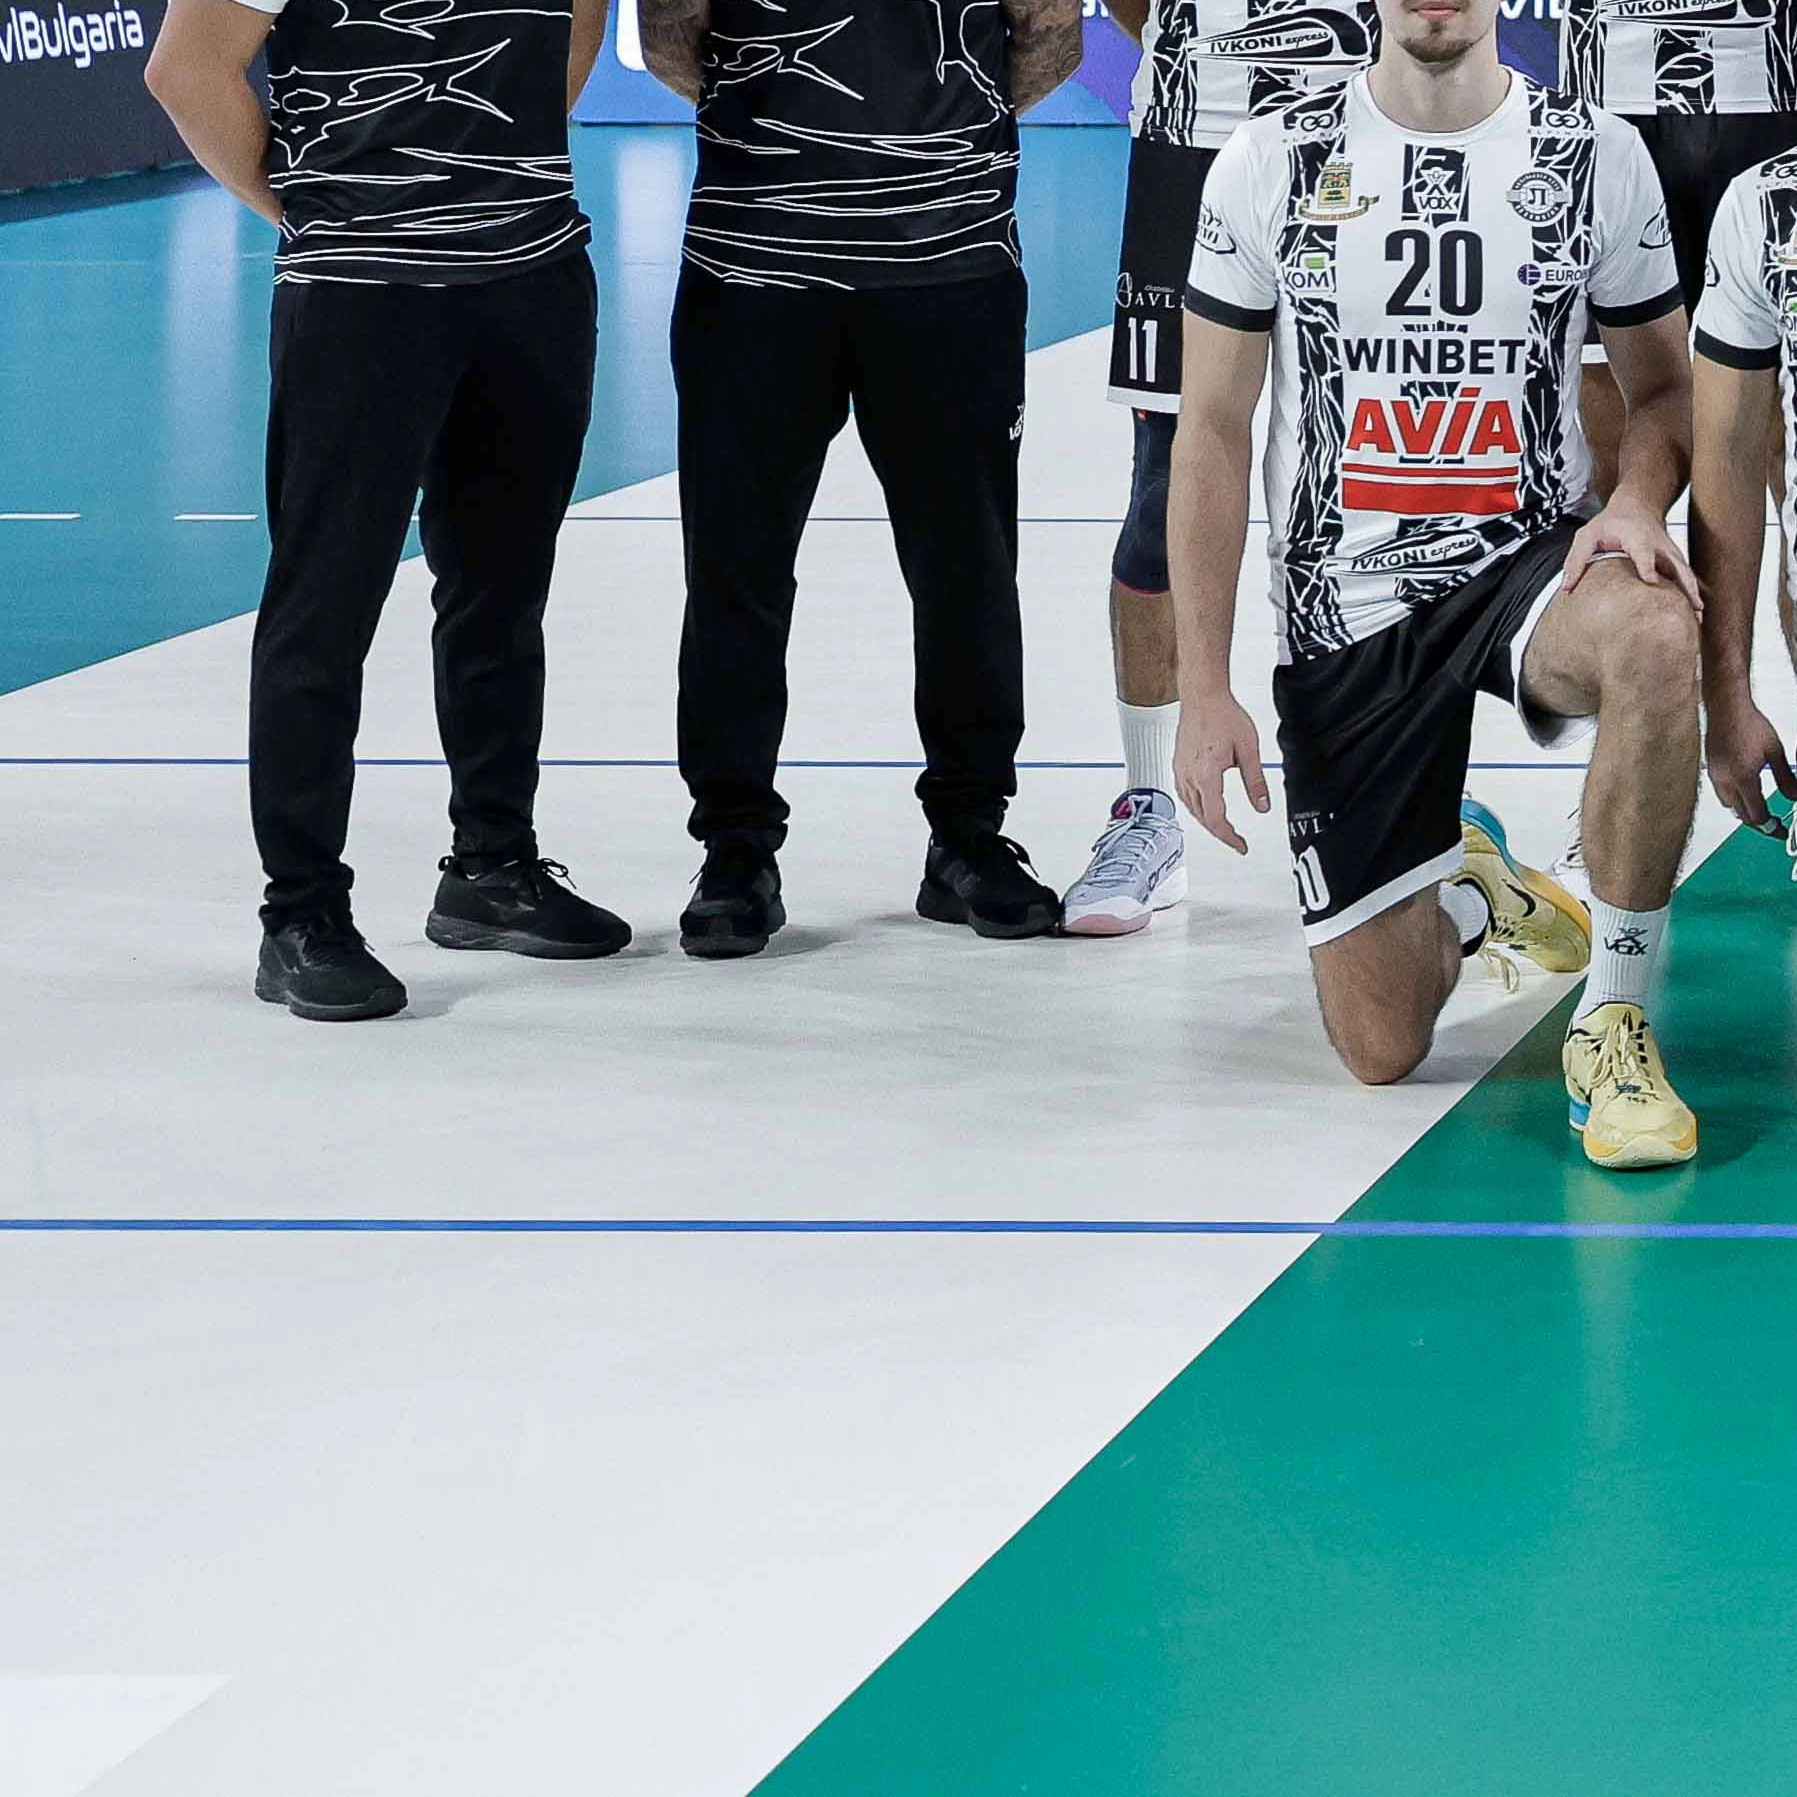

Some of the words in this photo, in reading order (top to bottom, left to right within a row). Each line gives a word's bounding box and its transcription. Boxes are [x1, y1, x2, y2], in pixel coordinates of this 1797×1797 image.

[1210, 35, 1282, 55] IVKONI
[1284, 29, 1330, 48] express
[1384, 229, 1482, 316] 20
[1128, 317, 1158, 383] 11
[1344, 338, 1524, 375] WINBET
[1352, 549, 1427, 571] IVKONI
[1429, 537, 1478, 559] express
